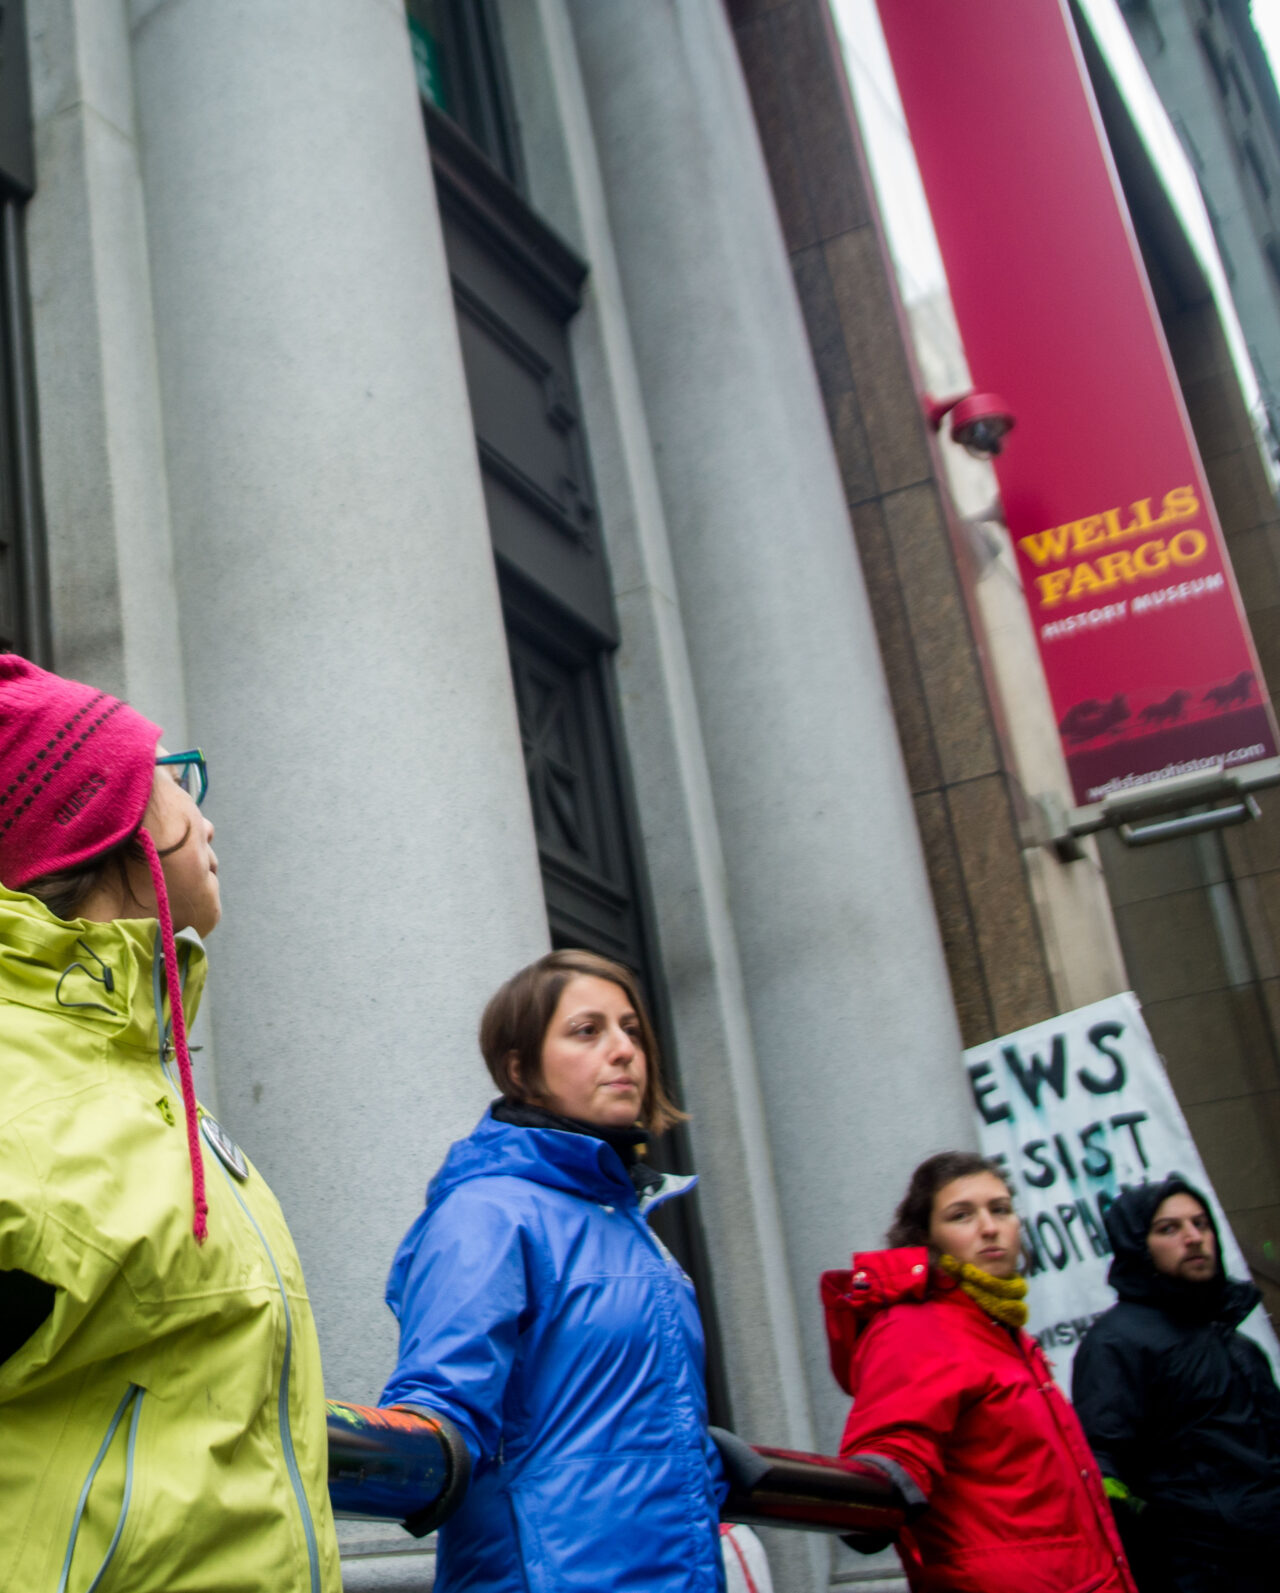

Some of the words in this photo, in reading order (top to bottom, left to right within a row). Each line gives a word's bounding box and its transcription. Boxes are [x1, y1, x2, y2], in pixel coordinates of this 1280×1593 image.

[1020, 484, 1199, 568] WELLS
[1035, 528, 1208, 610] FARGO
[1040, 600, 1128, 642] HISTORY
[1130, 571, 1224, 615] MUSEUM
[55, 773, 107, 826] GUESS
